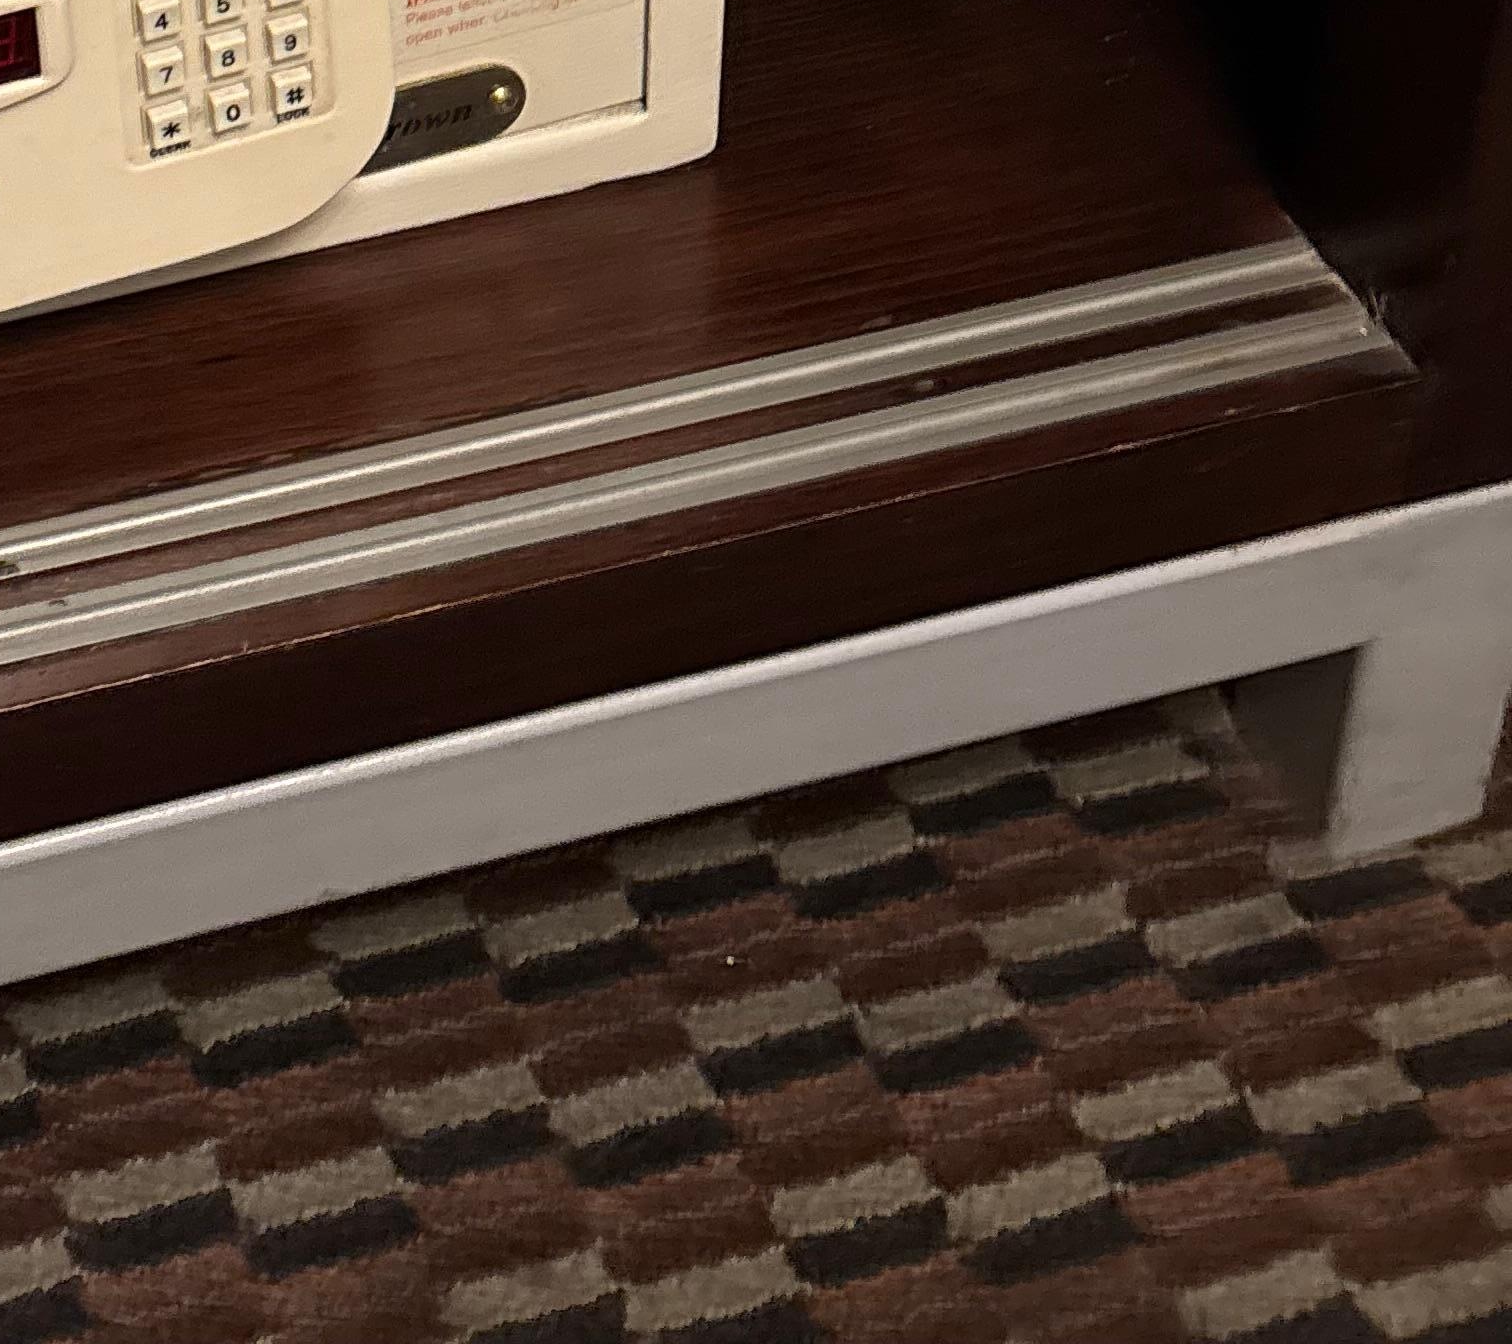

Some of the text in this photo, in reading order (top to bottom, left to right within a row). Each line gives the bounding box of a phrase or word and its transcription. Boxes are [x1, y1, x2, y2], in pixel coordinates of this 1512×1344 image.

[154, 13, 170, 31] 4
[159, 33, 298, 85] 7 8 9
[226, 85, 305, 123] 0 #
